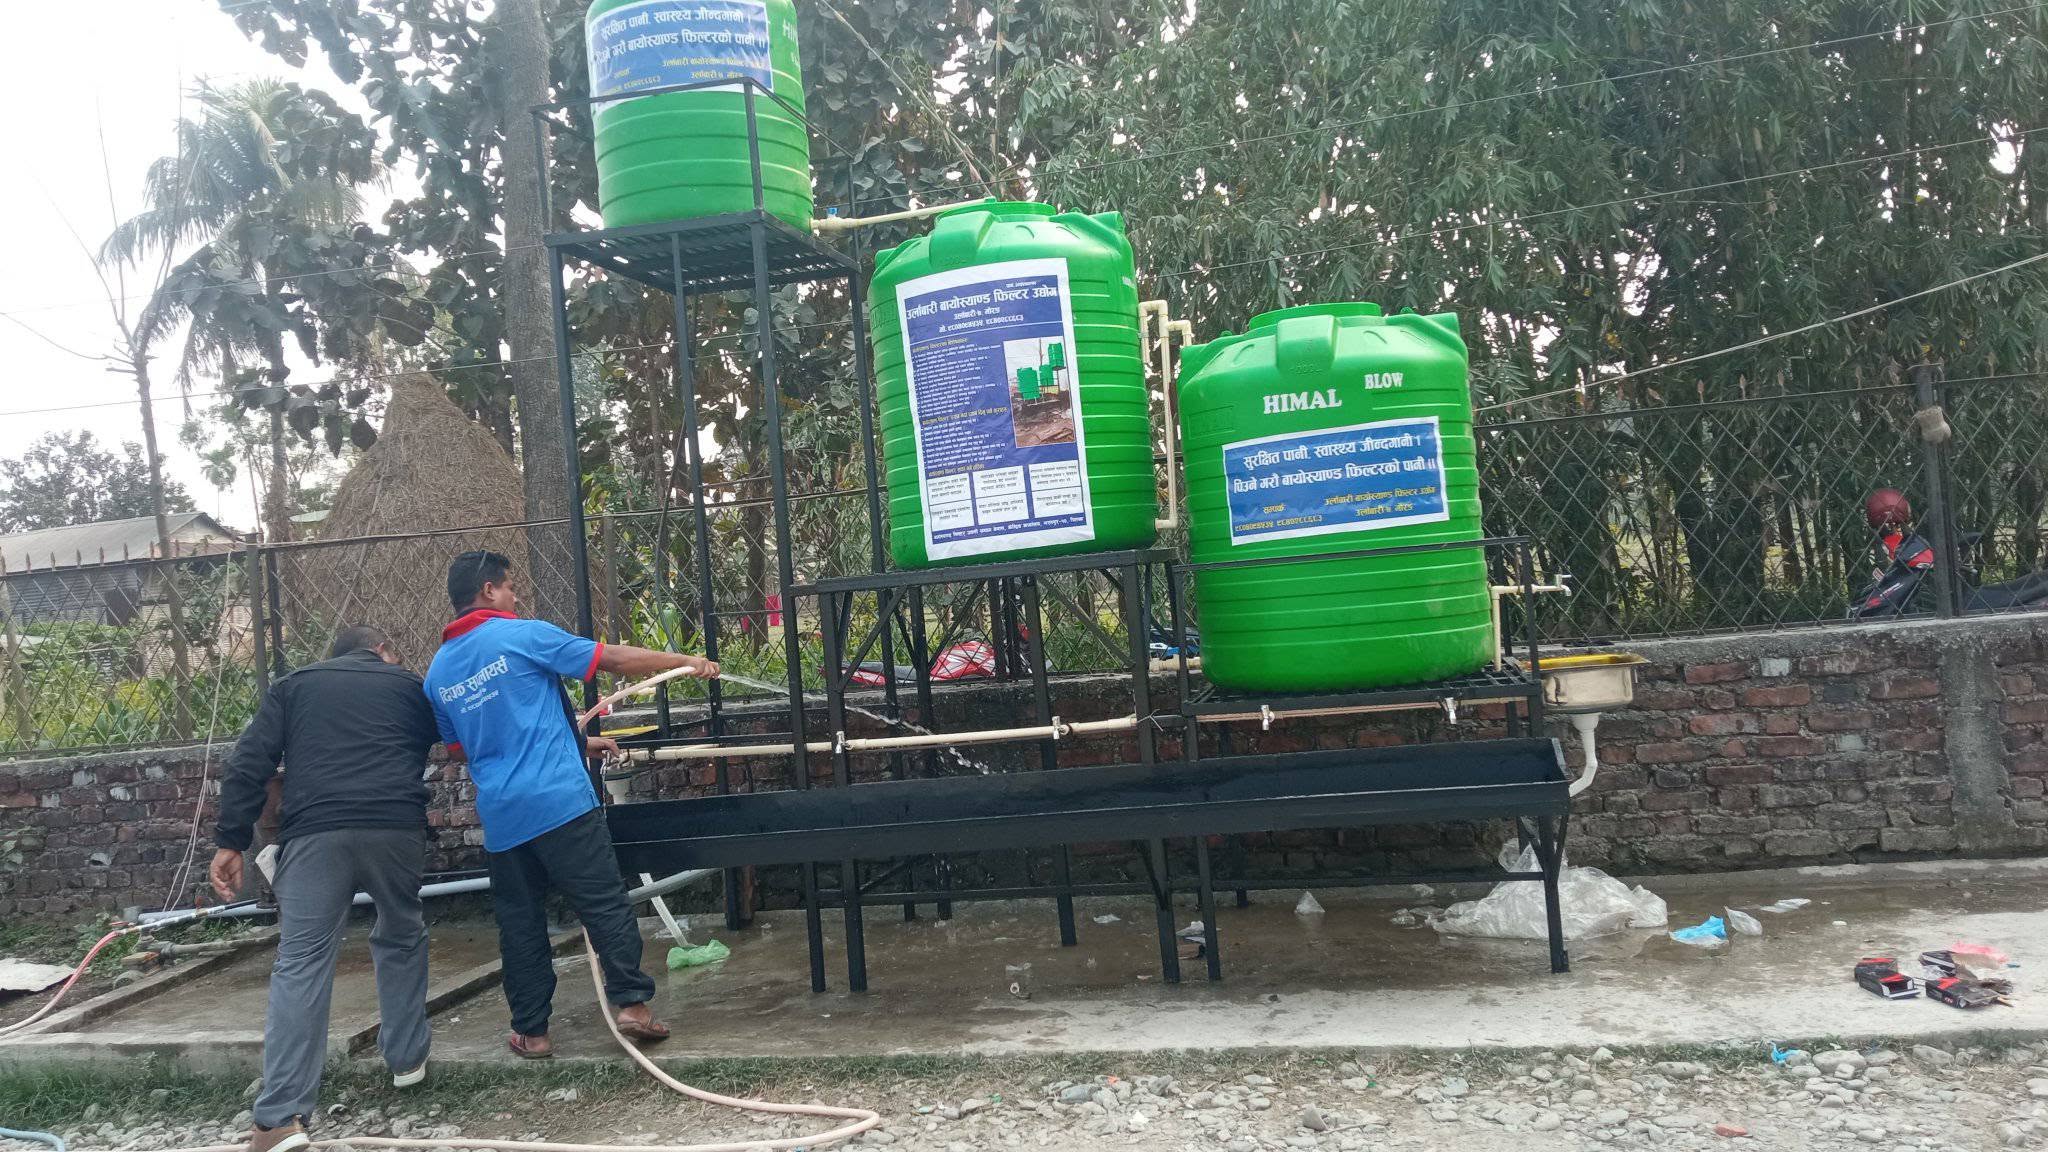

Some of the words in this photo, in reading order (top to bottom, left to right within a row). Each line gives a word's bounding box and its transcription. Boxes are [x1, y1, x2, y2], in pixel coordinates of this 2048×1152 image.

[994, 288, 1029, 303] फिल्टर
[1364, 372, 1404, 390] BLOW
[1263, 389, 1342, 414] HIMAL
[1243, 450, 1280, 471] सुरक्षित
[1233, 477, 1257, 493] पिउने
[1282, 468, 1343, 487] बायोस्याण्ड
[1345, 458, 1400, 478] फिल्टरको
[1402, 456, 1426, 472] पानी
